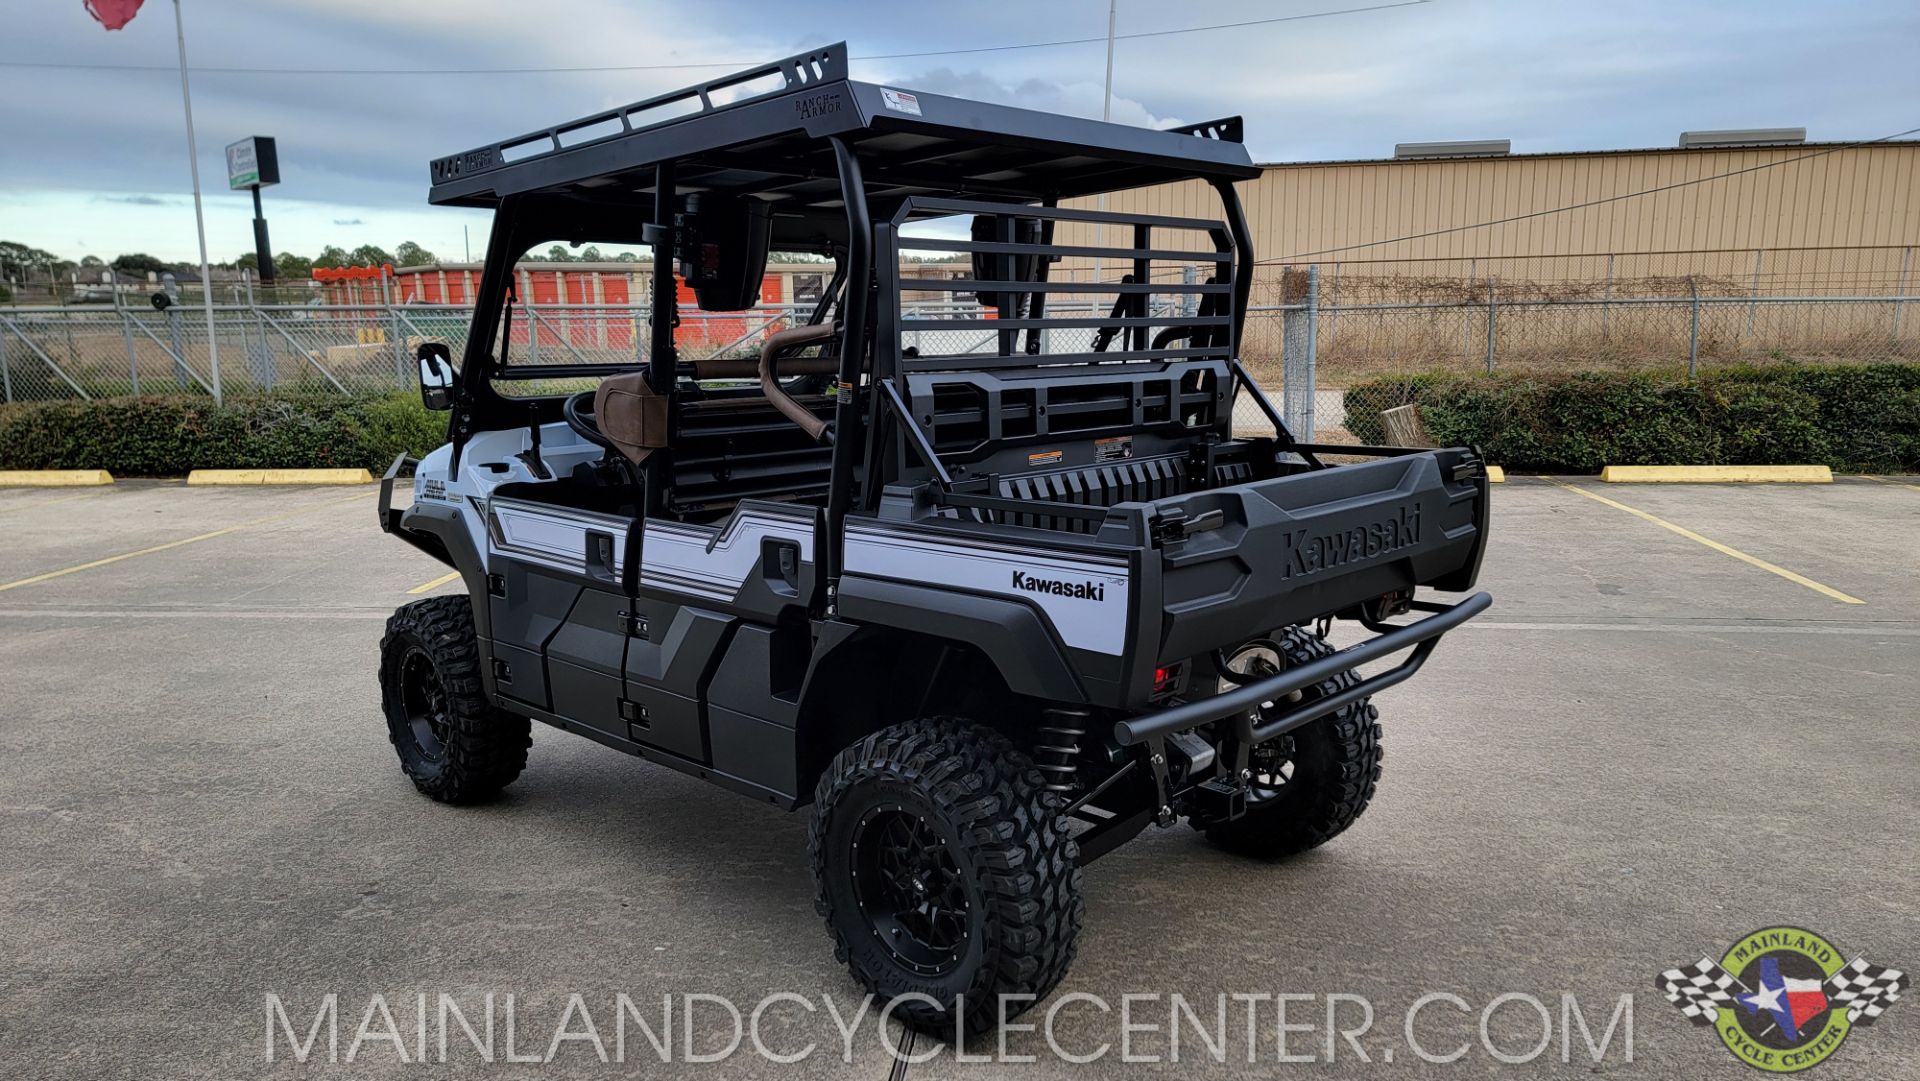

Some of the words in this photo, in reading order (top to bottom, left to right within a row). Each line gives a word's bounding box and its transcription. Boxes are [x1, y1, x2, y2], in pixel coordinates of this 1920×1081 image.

[795, 93, 829, 112] RANCH
[800, 98, 841, 120] ARMOR
[1281, 502, 1421, 580] Kawasaki
[1012, 570, 1105, 602] Kawasaki
